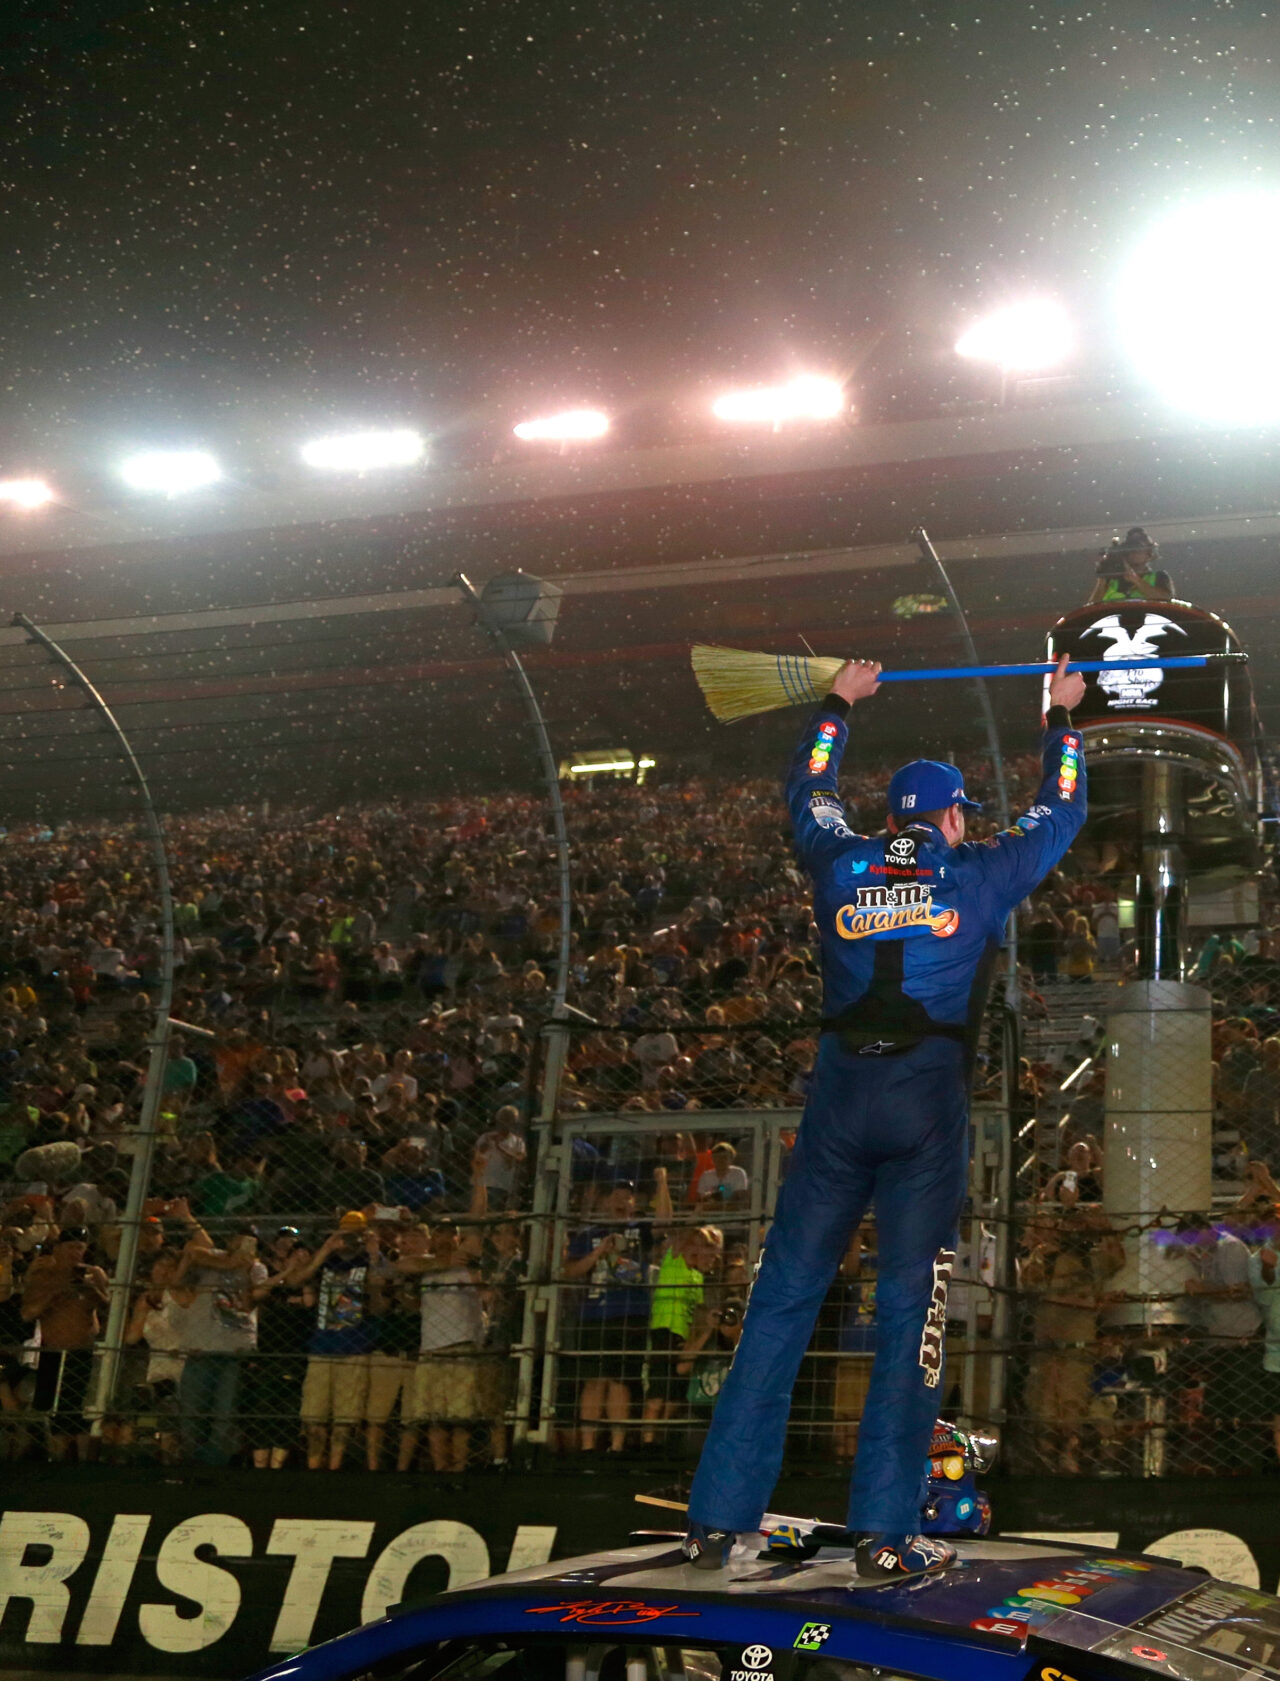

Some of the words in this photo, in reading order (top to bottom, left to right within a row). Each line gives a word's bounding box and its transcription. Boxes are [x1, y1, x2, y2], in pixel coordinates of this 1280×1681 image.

[901, 794, 917, 809] 18
[884, 854, 917, 865] TOYOA
[836, 895, 935, 940] Caramel
[689, 1543, 700, 1560] 18
[876, 1550, 898, 1570] 18
[730, 1670, 775, 1681] TOYOTA
